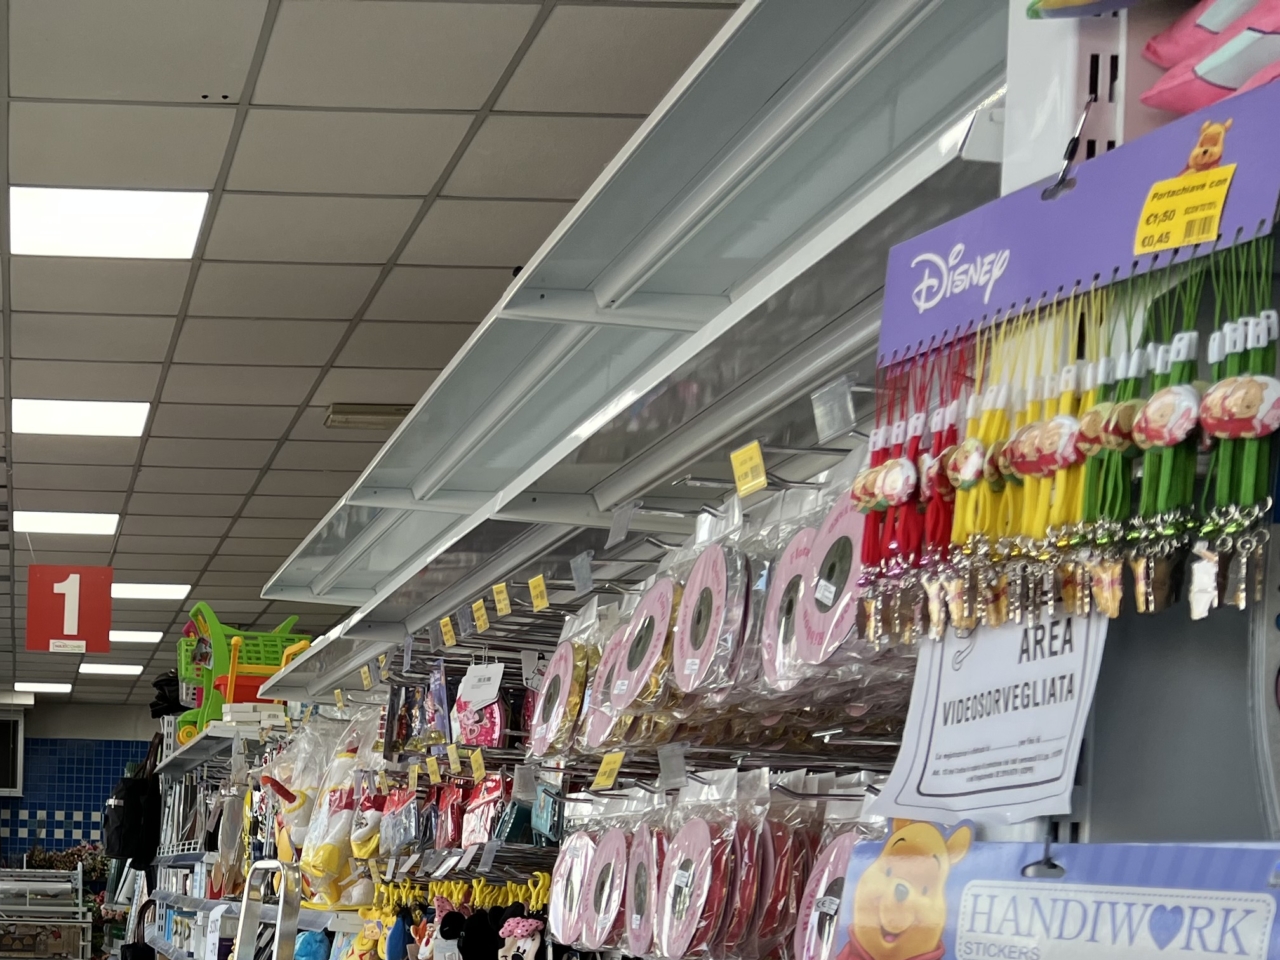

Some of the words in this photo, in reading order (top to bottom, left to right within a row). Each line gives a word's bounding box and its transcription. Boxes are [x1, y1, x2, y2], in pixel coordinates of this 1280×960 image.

[1151, 182, 1206, 201] Portachiave
[53, 573, 80, 636] 1
[1018, 617, 1074, 664] AREA
[943, 673, 1075, 726] VIDEOSORVEGLIATA
